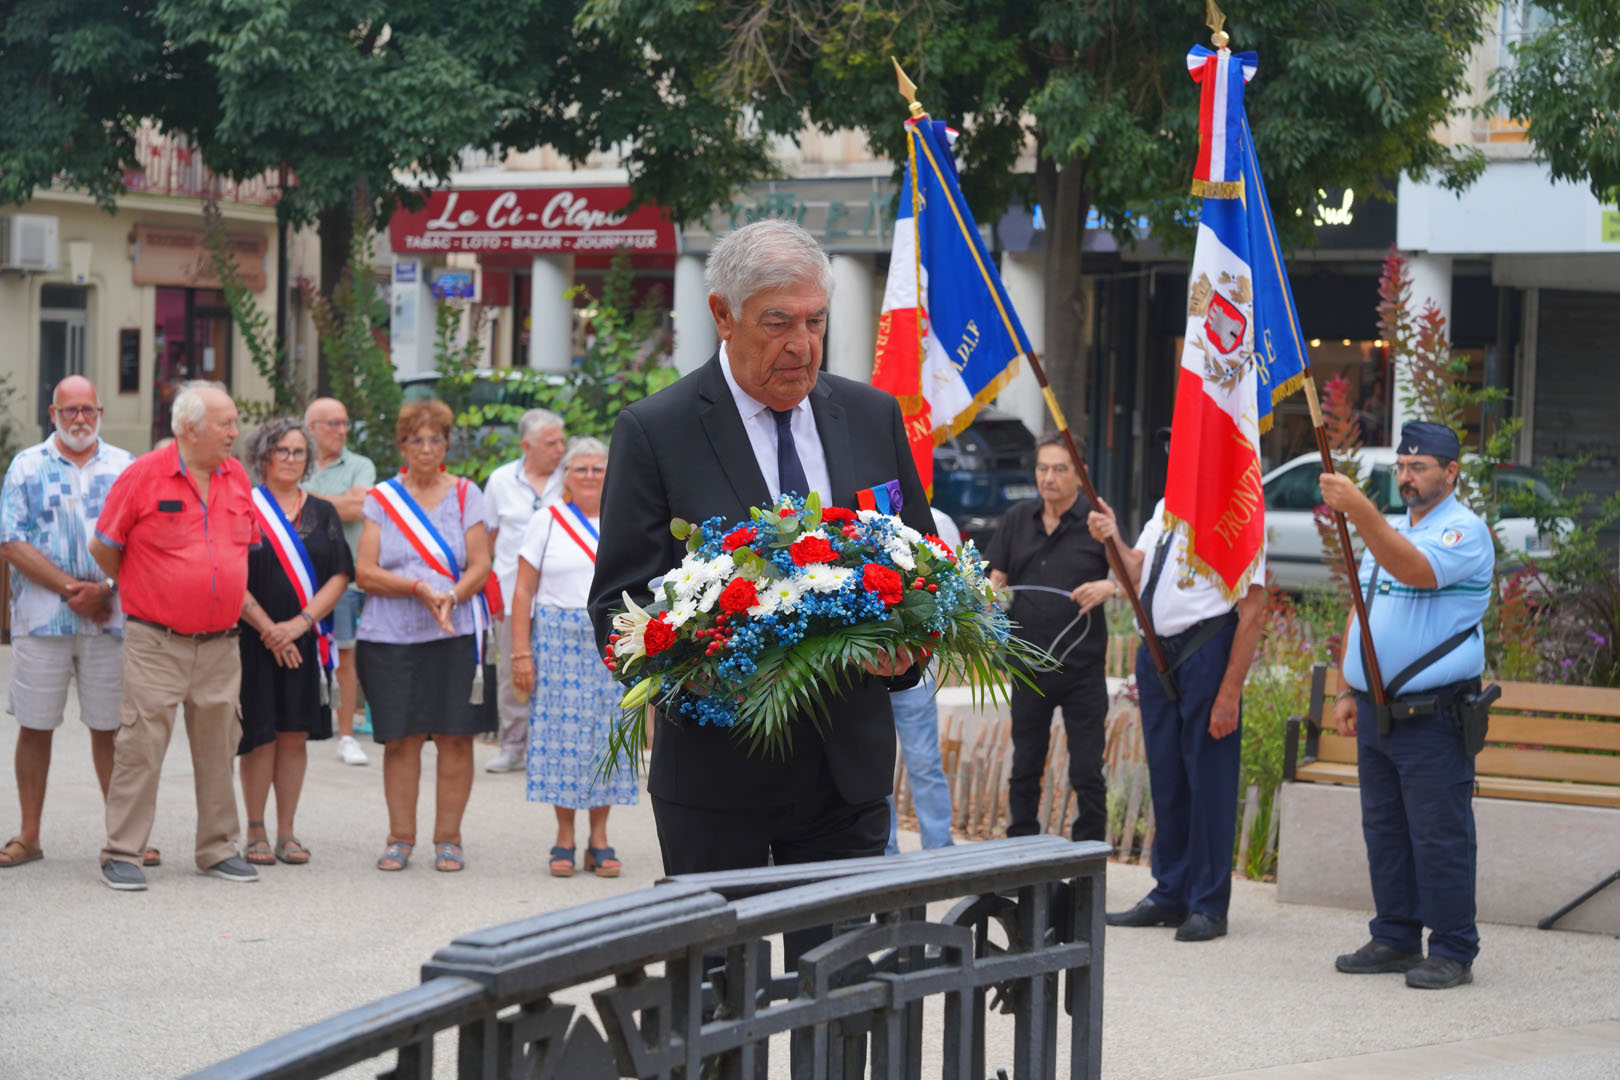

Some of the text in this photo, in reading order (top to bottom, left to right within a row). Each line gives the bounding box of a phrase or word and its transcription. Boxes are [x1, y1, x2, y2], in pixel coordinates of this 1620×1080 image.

[426, 192, 478, 230] Le
[405, 235, 450, 249] TABAC
[461, 236, 501, 249] LOTO
[511, 236, 562, 249] BAZAR
